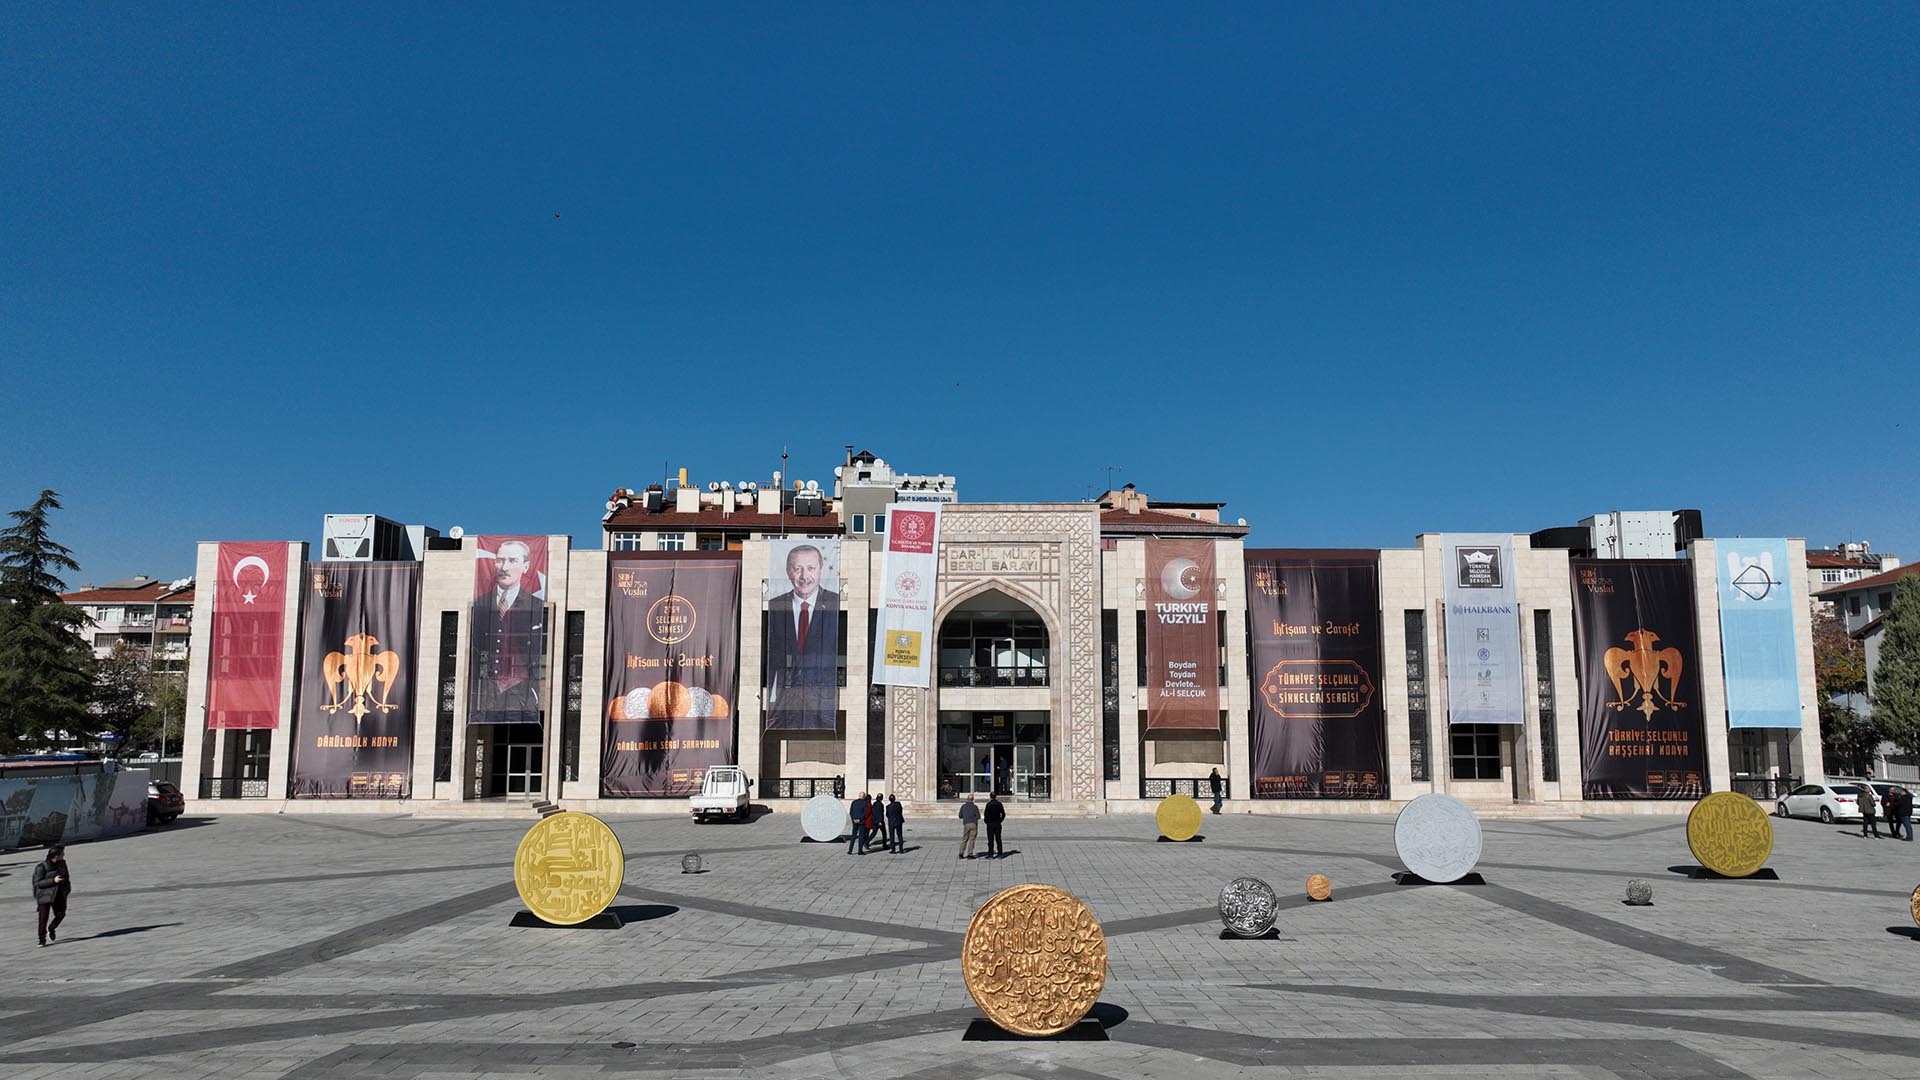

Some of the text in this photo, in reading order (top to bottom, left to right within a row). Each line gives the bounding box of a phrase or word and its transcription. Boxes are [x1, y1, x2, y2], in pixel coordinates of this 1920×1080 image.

[1003, 548, 1037, 560] MÜLK
[991, 561, 1037, 571] SARAYI
[1463, 606, 1512, 614] HALKBANK
[1168, 661, 1197, 670] Boydan
[1169, 671, 1197, 680] Toydan
[1278, 672, 1359, 687] TÜRKİYE SELÇUKLU
[1177, 689, 1206, 698] SELÇUK
[1326, 691, 1359, 703] SERGİSİ
[1609, 729, 1688, 743] TÜRKİYE SELÇUKLU
[371, 736, 399, 748] KONYA
[1660, 745, 1689, 756] KONYA
